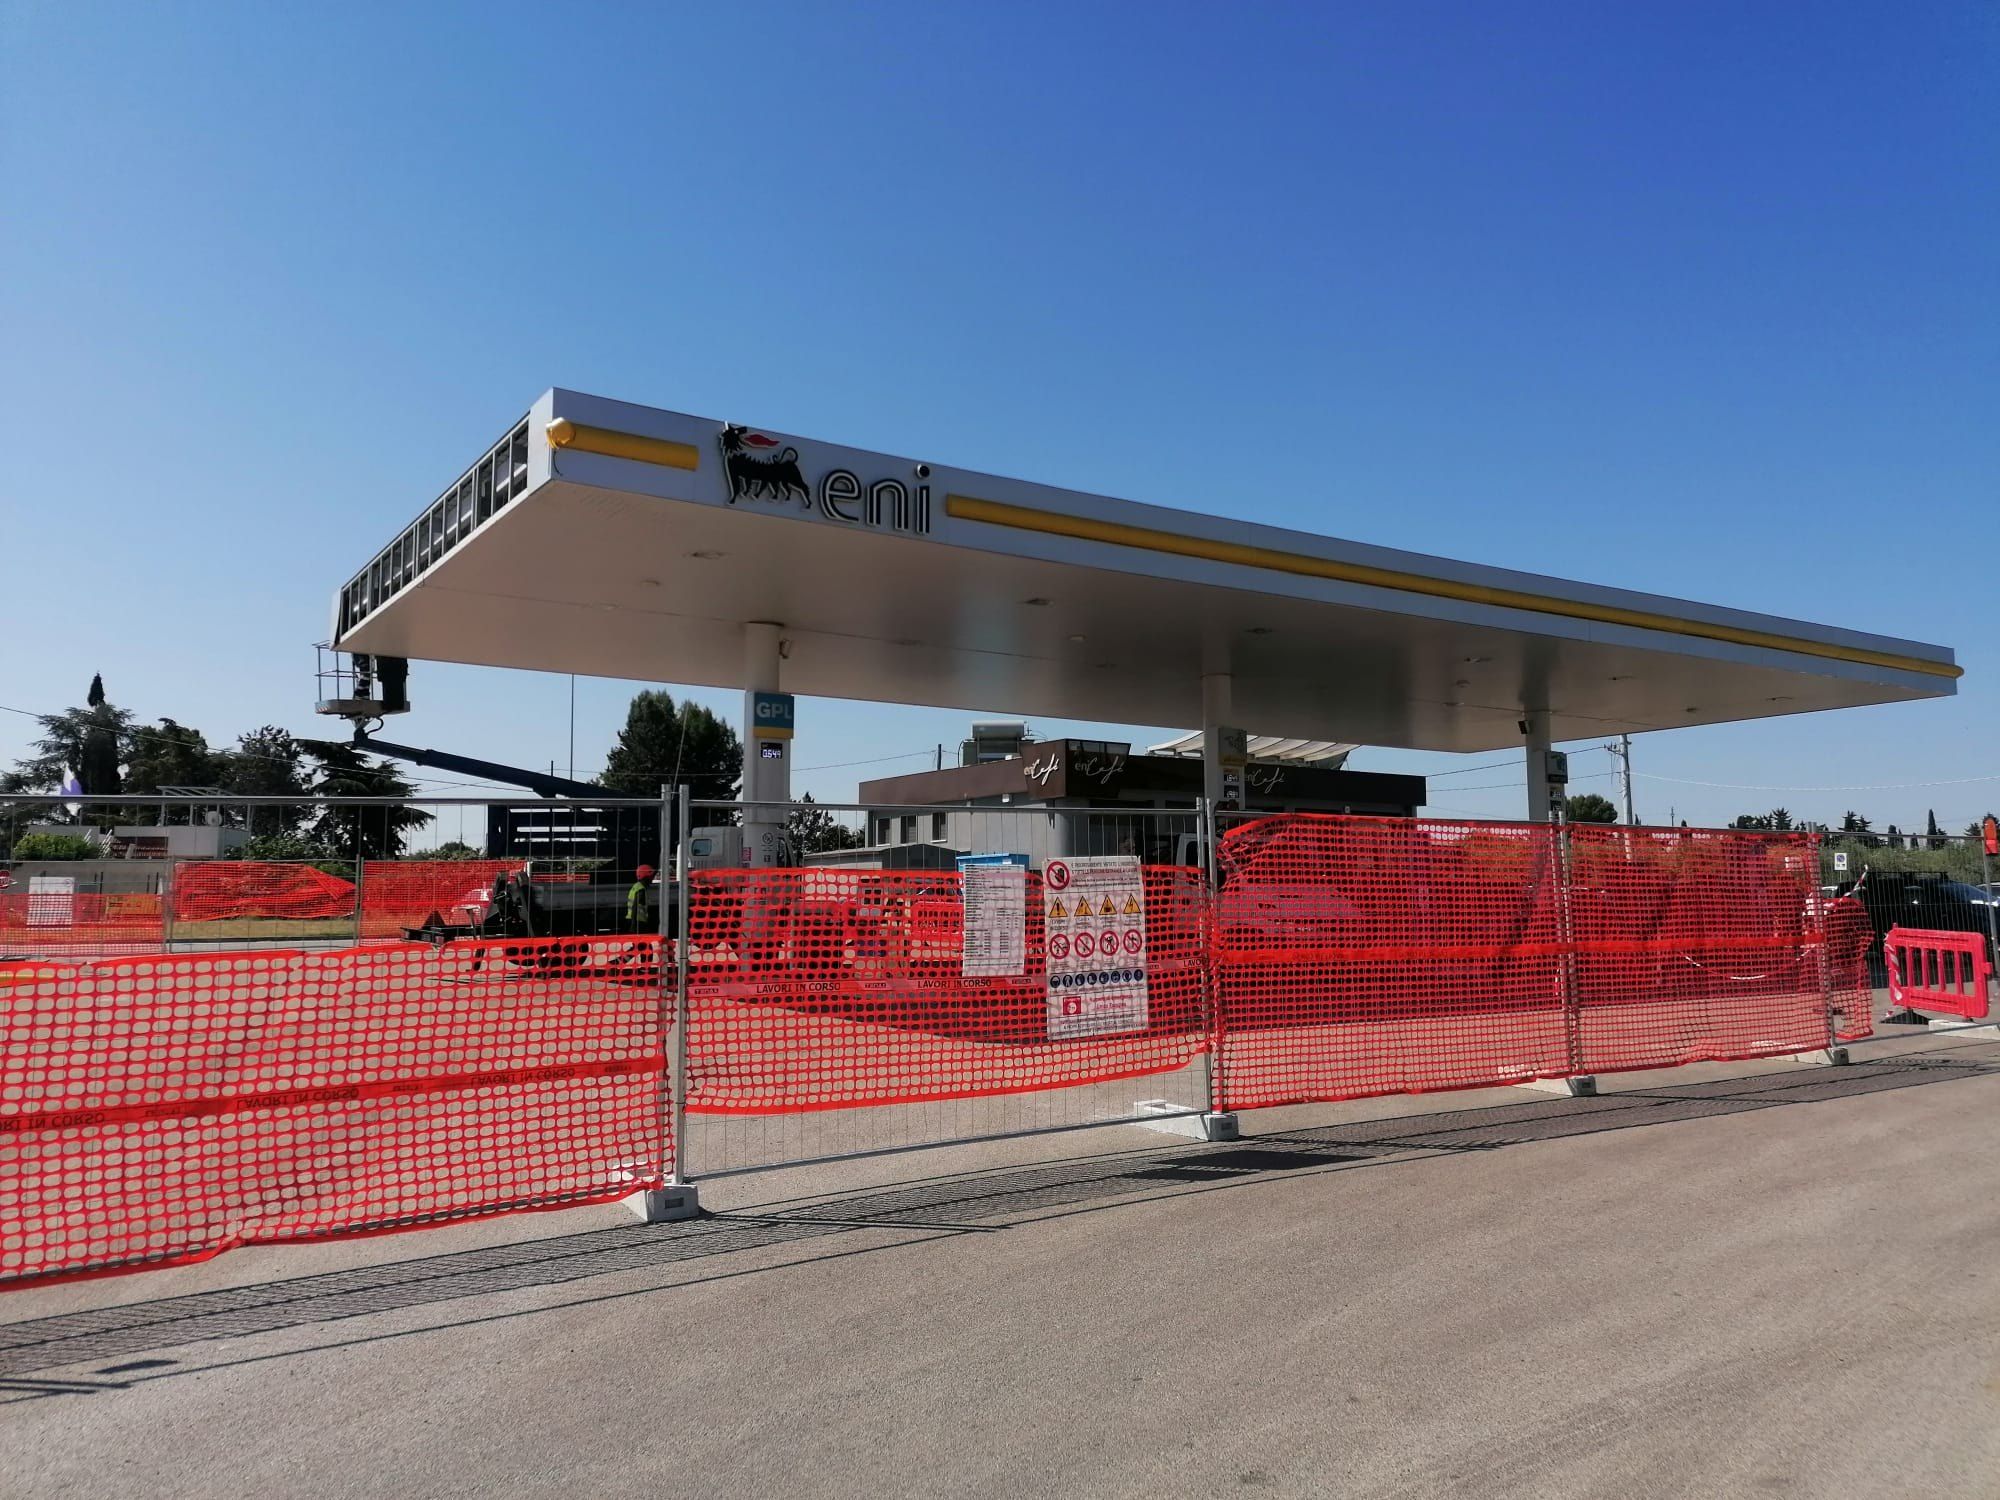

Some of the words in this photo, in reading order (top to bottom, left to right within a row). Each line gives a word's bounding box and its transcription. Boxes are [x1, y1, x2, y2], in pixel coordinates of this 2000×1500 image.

[819, 464, 931, 534] eni
[756, 702, 792, 719] GPL
[756, 983, 792, 994] LAVORI
[795, 983, 806, 993] IN
[808, 981, 841, 992] CORSO
[963, 978, 992, 988] CORSO
